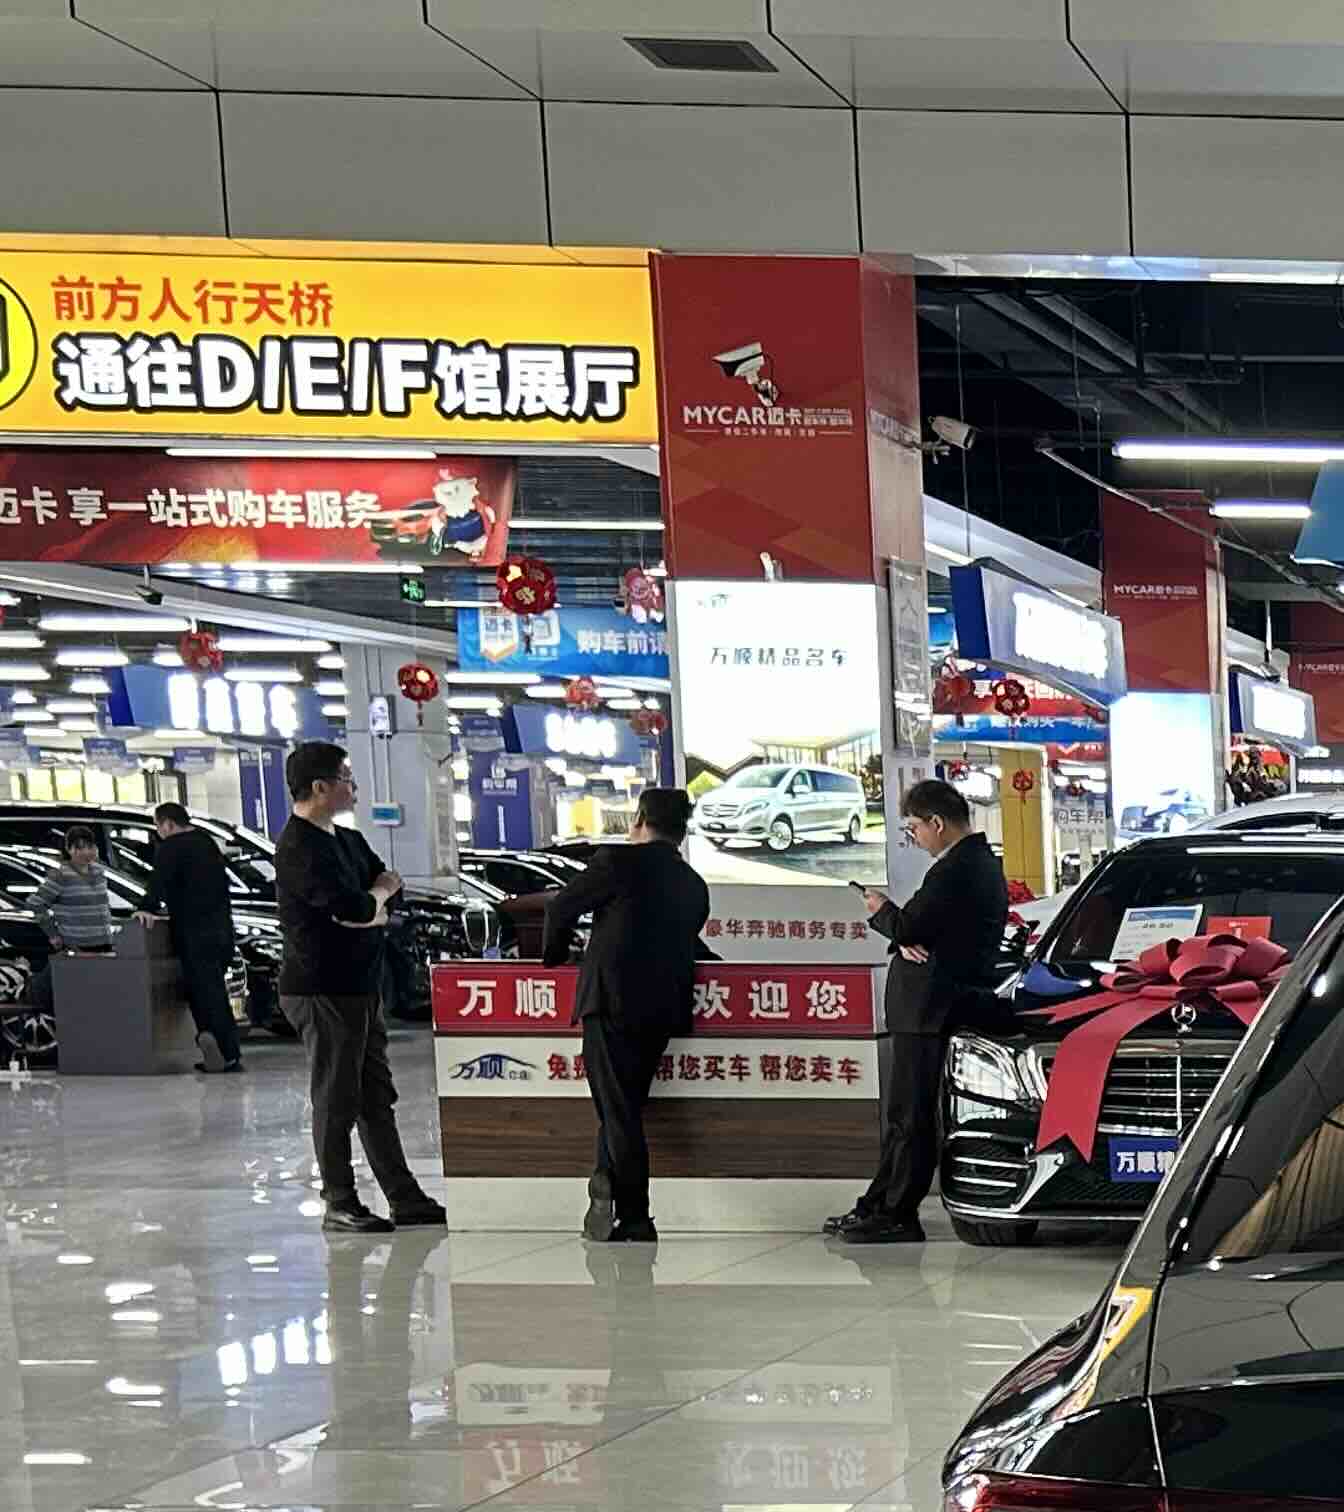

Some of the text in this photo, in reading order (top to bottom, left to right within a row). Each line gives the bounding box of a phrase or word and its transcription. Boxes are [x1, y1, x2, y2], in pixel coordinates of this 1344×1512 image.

[51, 275, 334, 327] 前方人行天桥
[55, 335, 638, 420] 通往D/E/F馆展厅
[709, 646, 847, 667] 万顺精品名车
[704, 918, 868, 941] 豪华奔驰商务专卖
[761, 1055, 861, 1084] 帮您卖车
